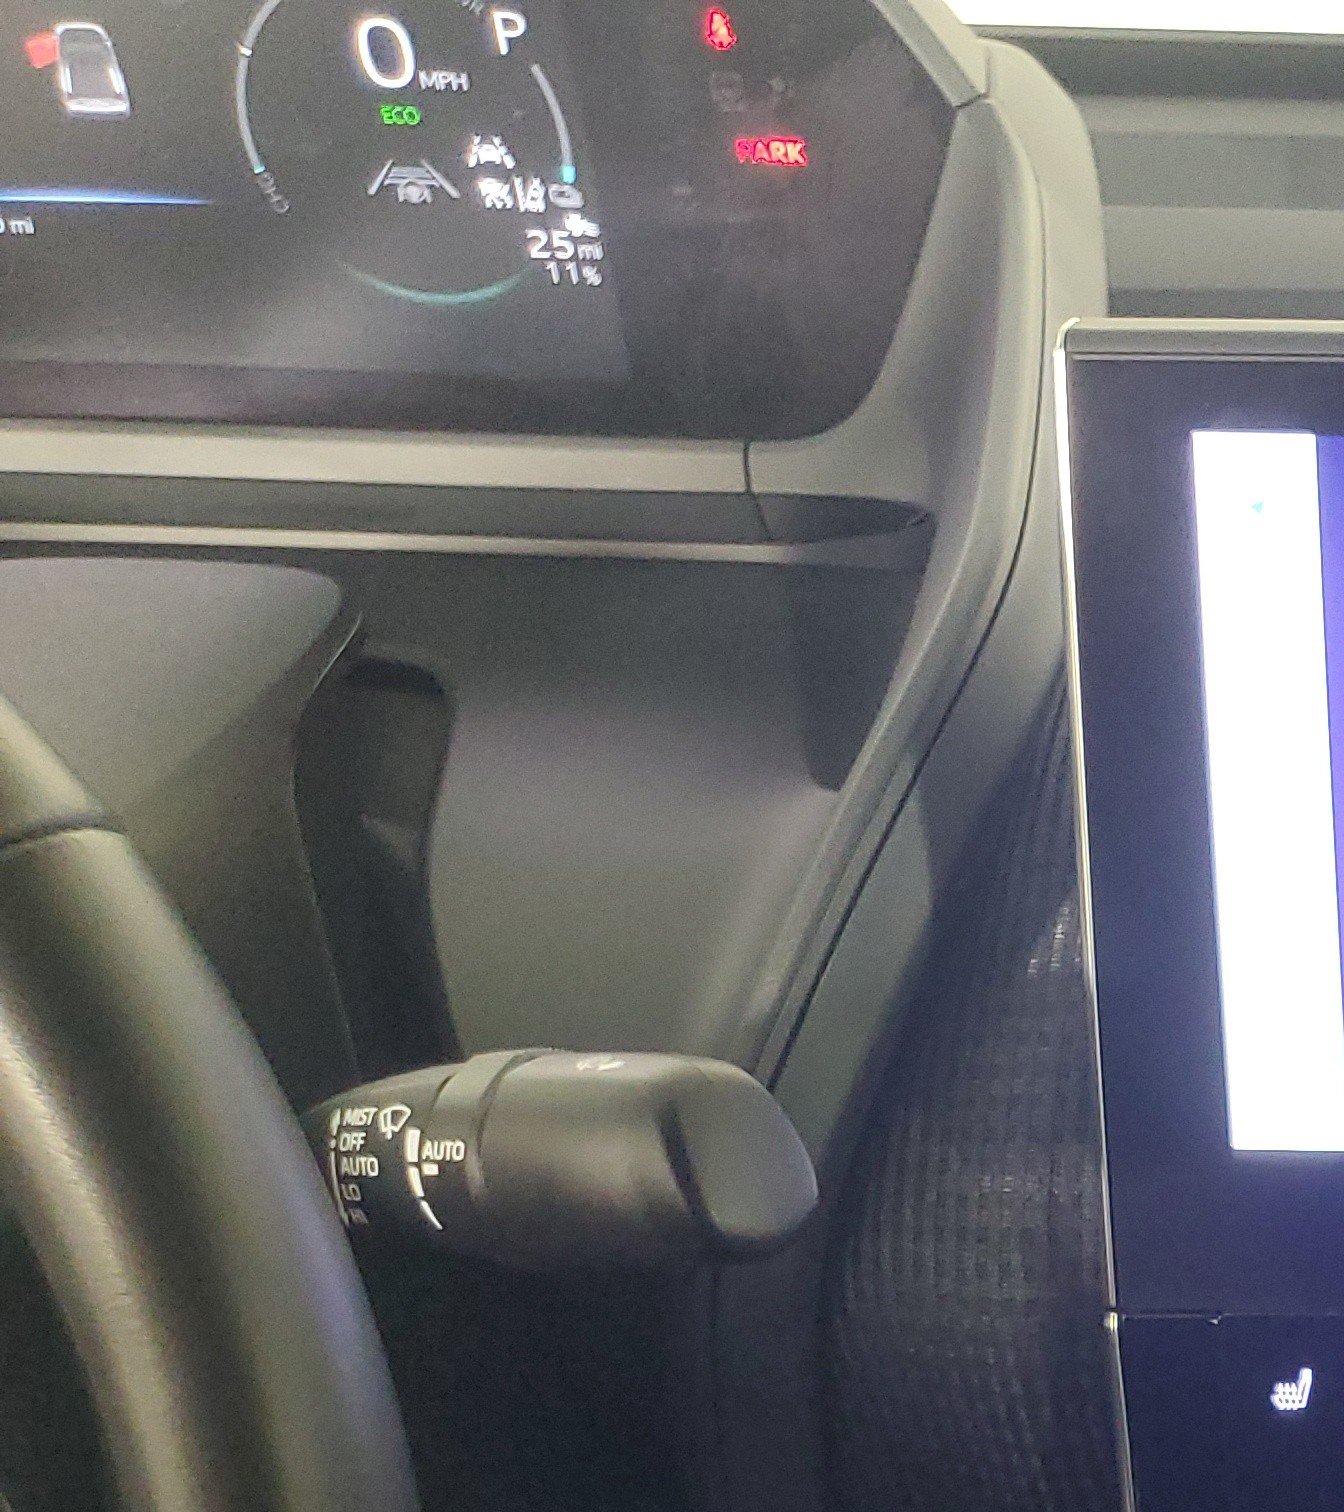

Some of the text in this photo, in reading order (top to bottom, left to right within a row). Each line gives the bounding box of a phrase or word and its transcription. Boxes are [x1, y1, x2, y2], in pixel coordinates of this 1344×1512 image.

[492, 11, 526, 55] P
[356, 17, 470, 91] 0 MPH
[380, 105, 420, 125] ECO
[736, 138, 807, 166] PARK
[526, 229, 604, 260] 25 mi
[343, 1107, 378, 1126] MIST
[340, 1132, 366, 1152] OFF
[422, 1140, 465, 1161] AUTO
[341, 1157, 379, 1177] AUTO
[341, 1184, 361, 1201] LO
